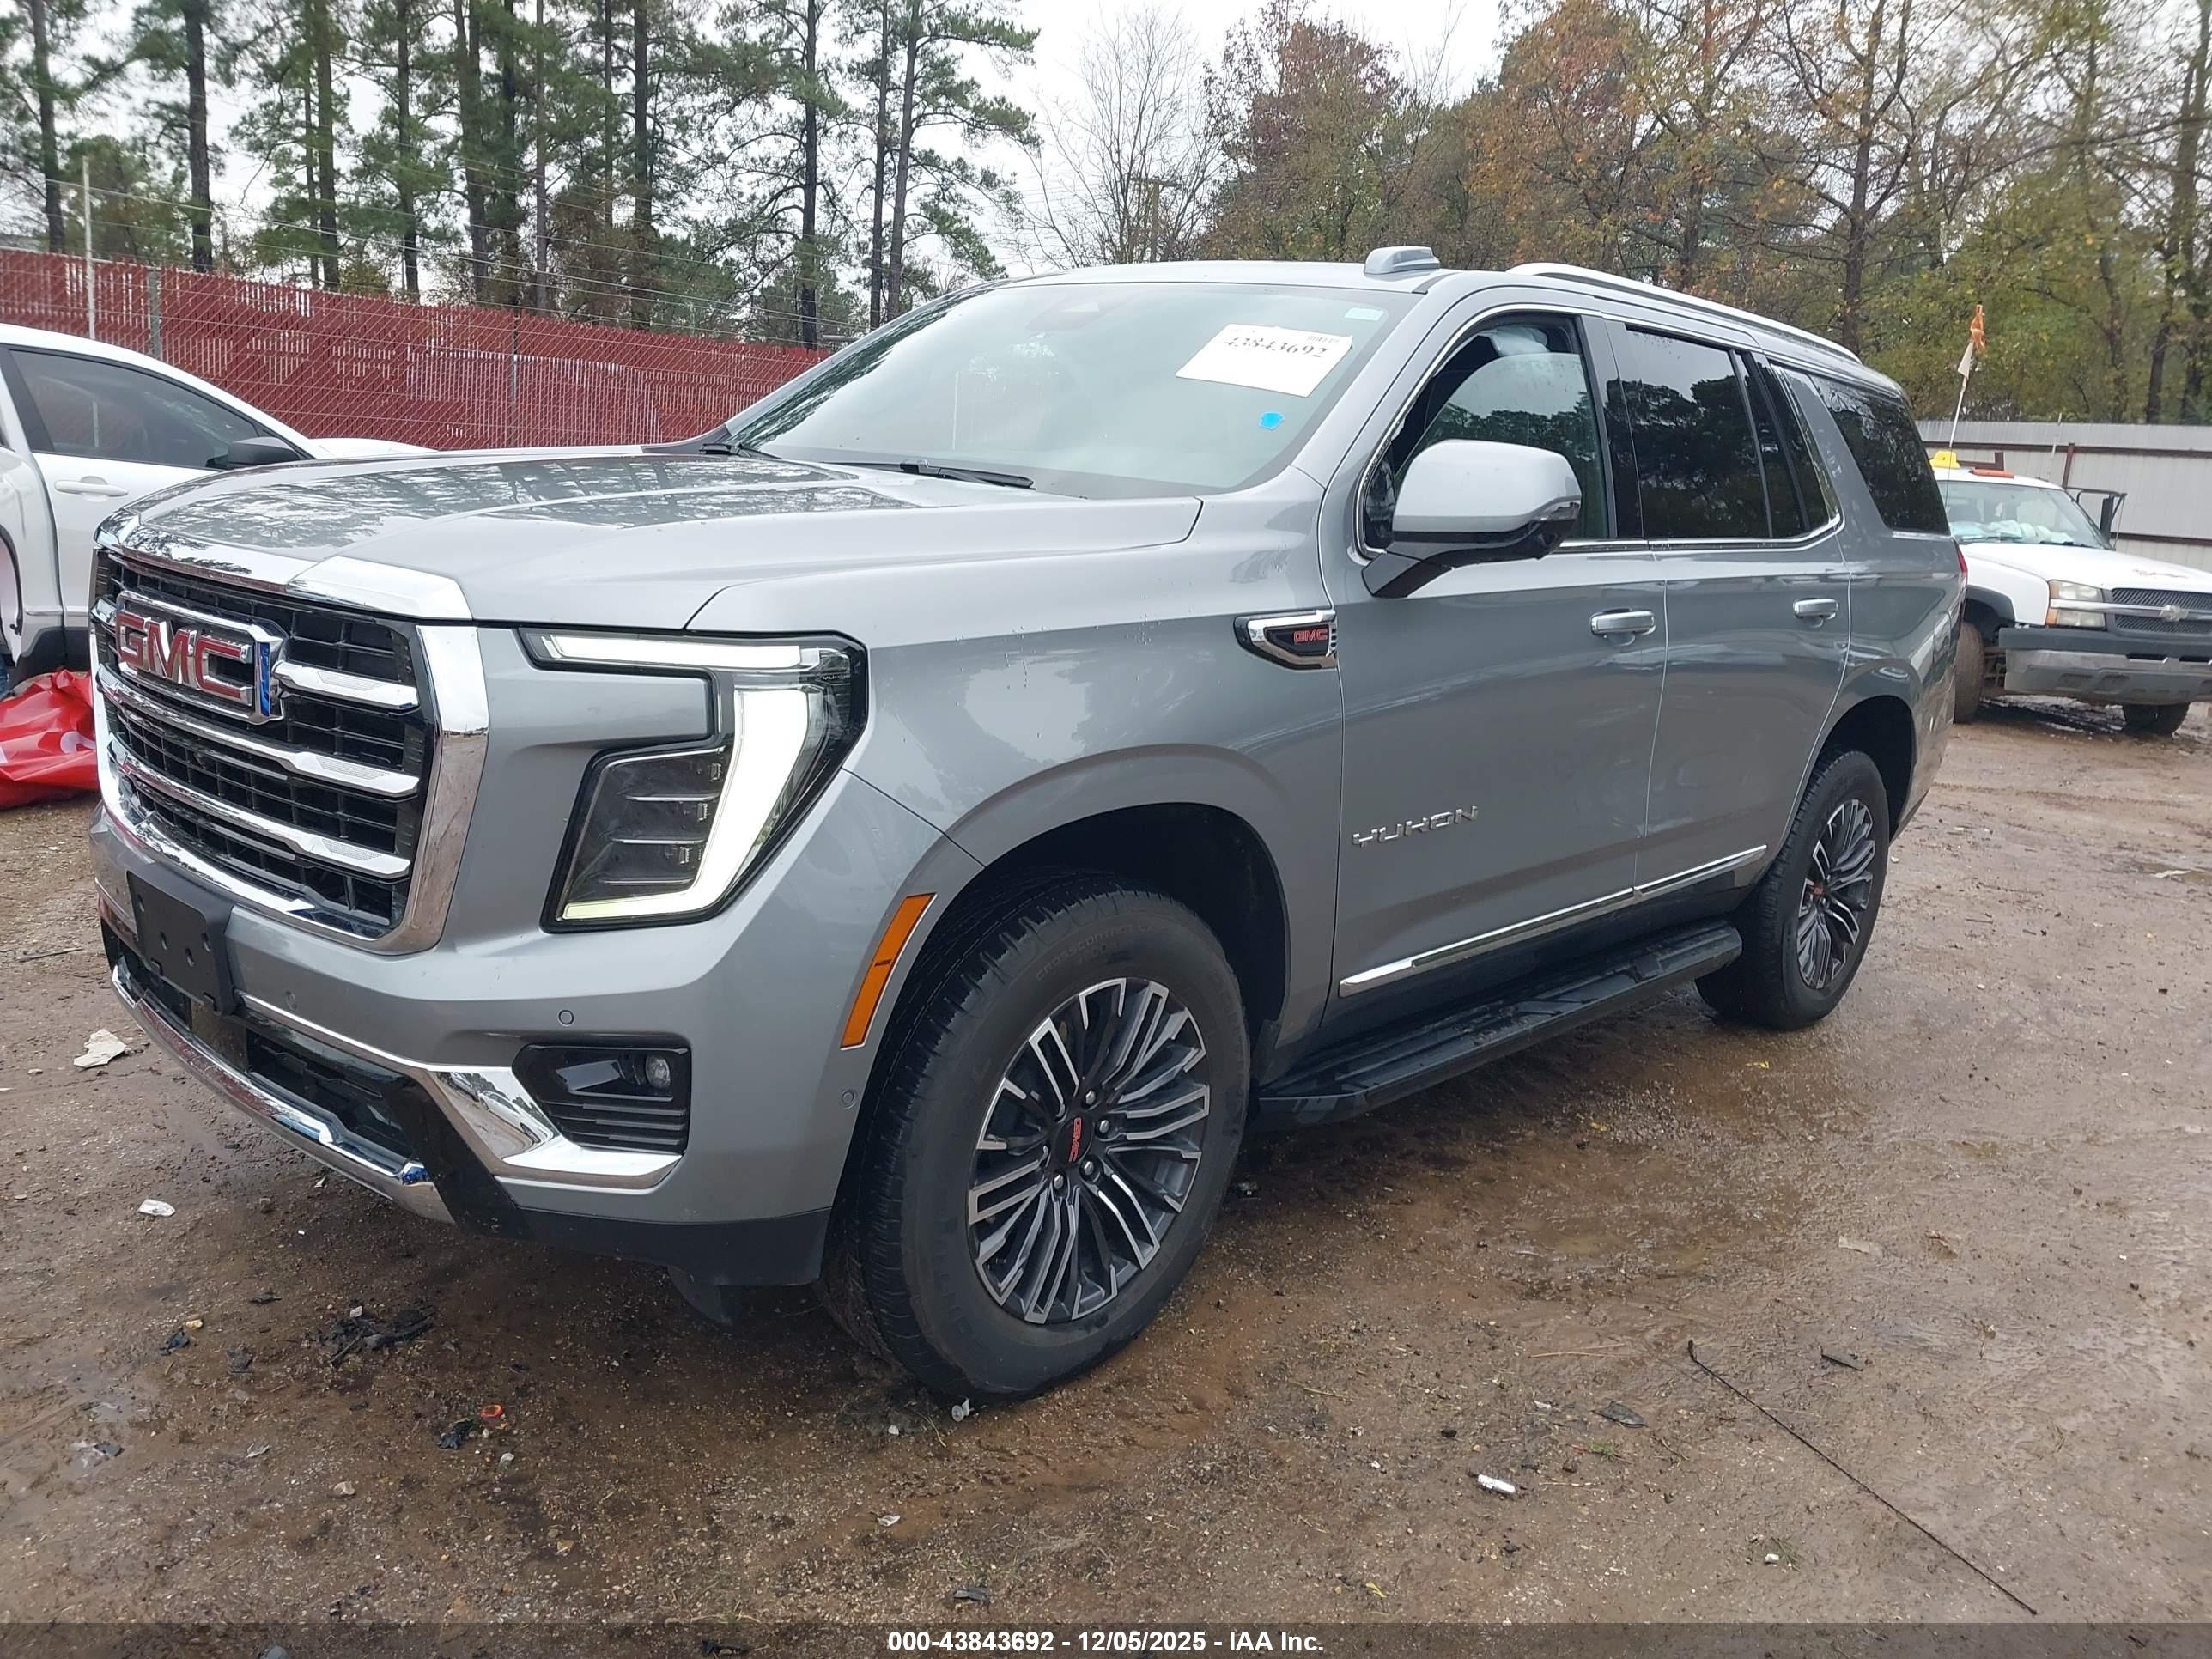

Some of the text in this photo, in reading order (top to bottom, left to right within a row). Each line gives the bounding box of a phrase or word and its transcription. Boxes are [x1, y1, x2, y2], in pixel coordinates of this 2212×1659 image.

[1224, 336, 1328, 358] 43843692
[1293, 628, 1328, 642] GMC
[115, 611, 252, 706] GMC
[1352, 805, 1479, 848] YUKON
[1068, 1116, 1082, 1162] GMC
